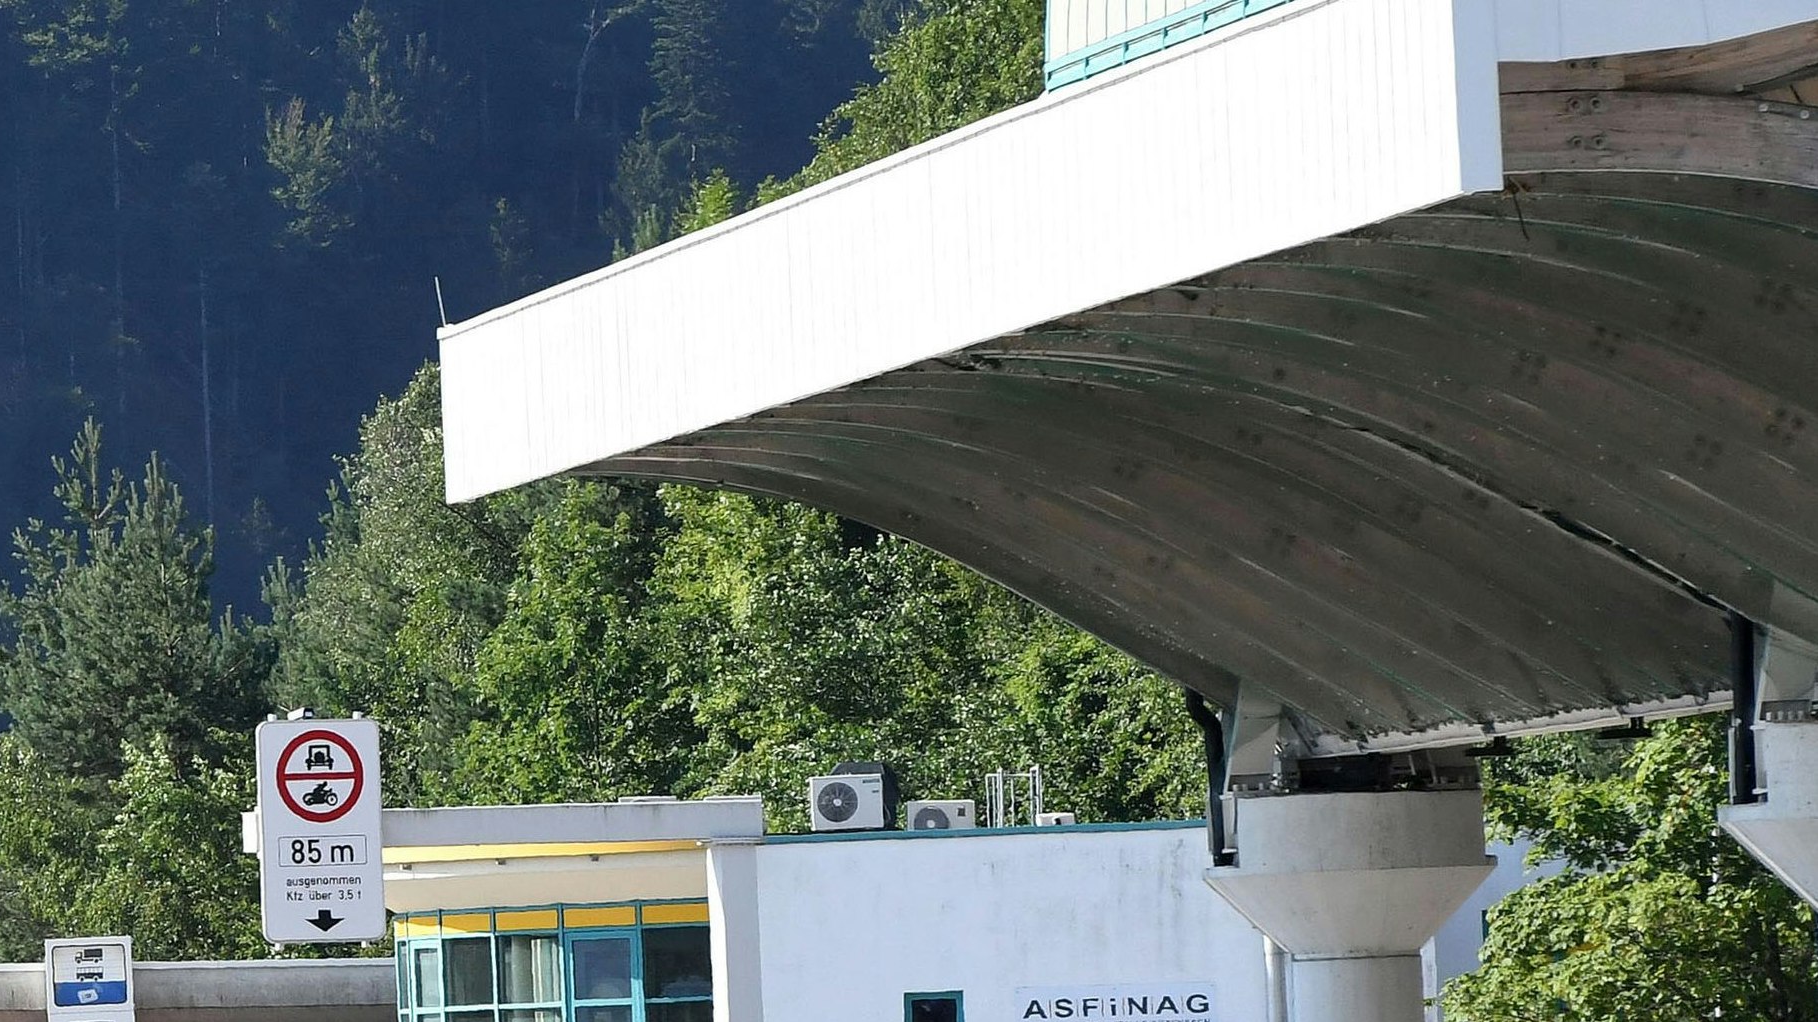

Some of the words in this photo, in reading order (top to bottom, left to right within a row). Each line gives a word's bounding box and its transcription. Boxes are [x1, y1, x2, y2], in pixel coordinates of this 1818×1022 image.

[291, 839, 322, 864] 85
[330, 845, 354, 862] m
[286, 875, 362, 888] ausgenommen
[286, 890, 304, 901] Kfz
[309, 890, 332, 900] über
